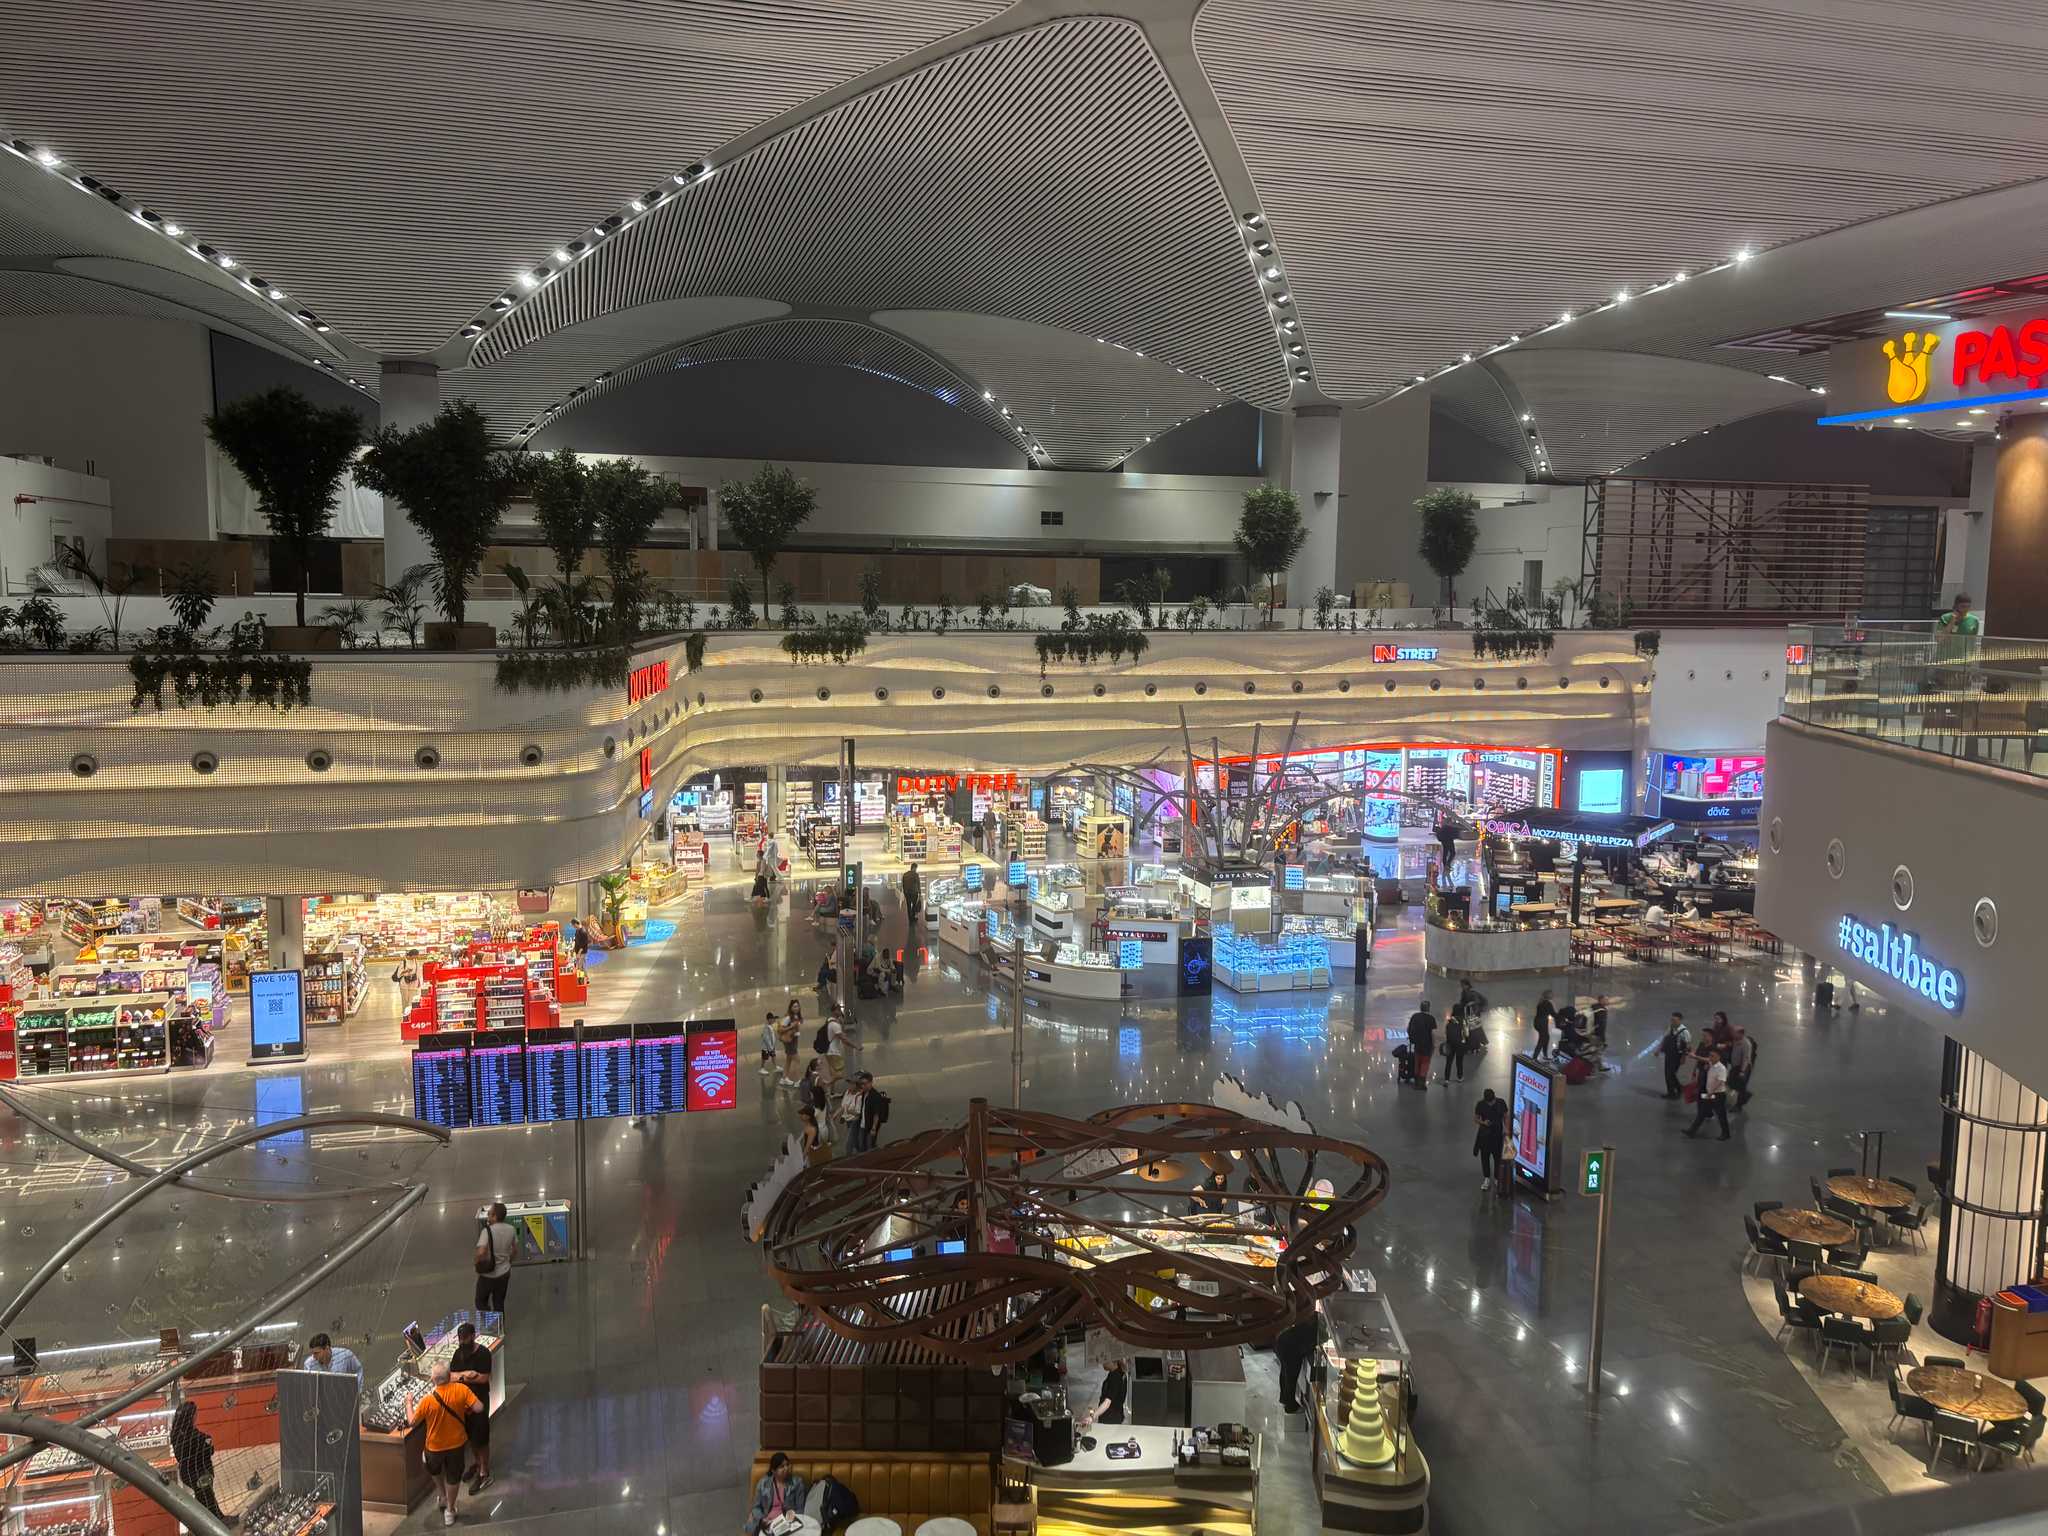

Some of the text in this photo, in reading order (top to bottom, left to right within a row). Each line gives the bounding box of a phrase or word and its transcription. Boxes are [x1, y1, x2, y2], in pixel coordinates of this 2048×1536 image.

[1953, 319, 2048, 389] PAŞ
[1374, 645, 1438, 662] IN STREET
[897, 773, 1018, 793] DUTY FREE
[1707, 806, 1730, 817] döviz
[1532, 829, 1585, 842] MOZZARELLA
[1839, 915, 1958, 1009] #saltbae
